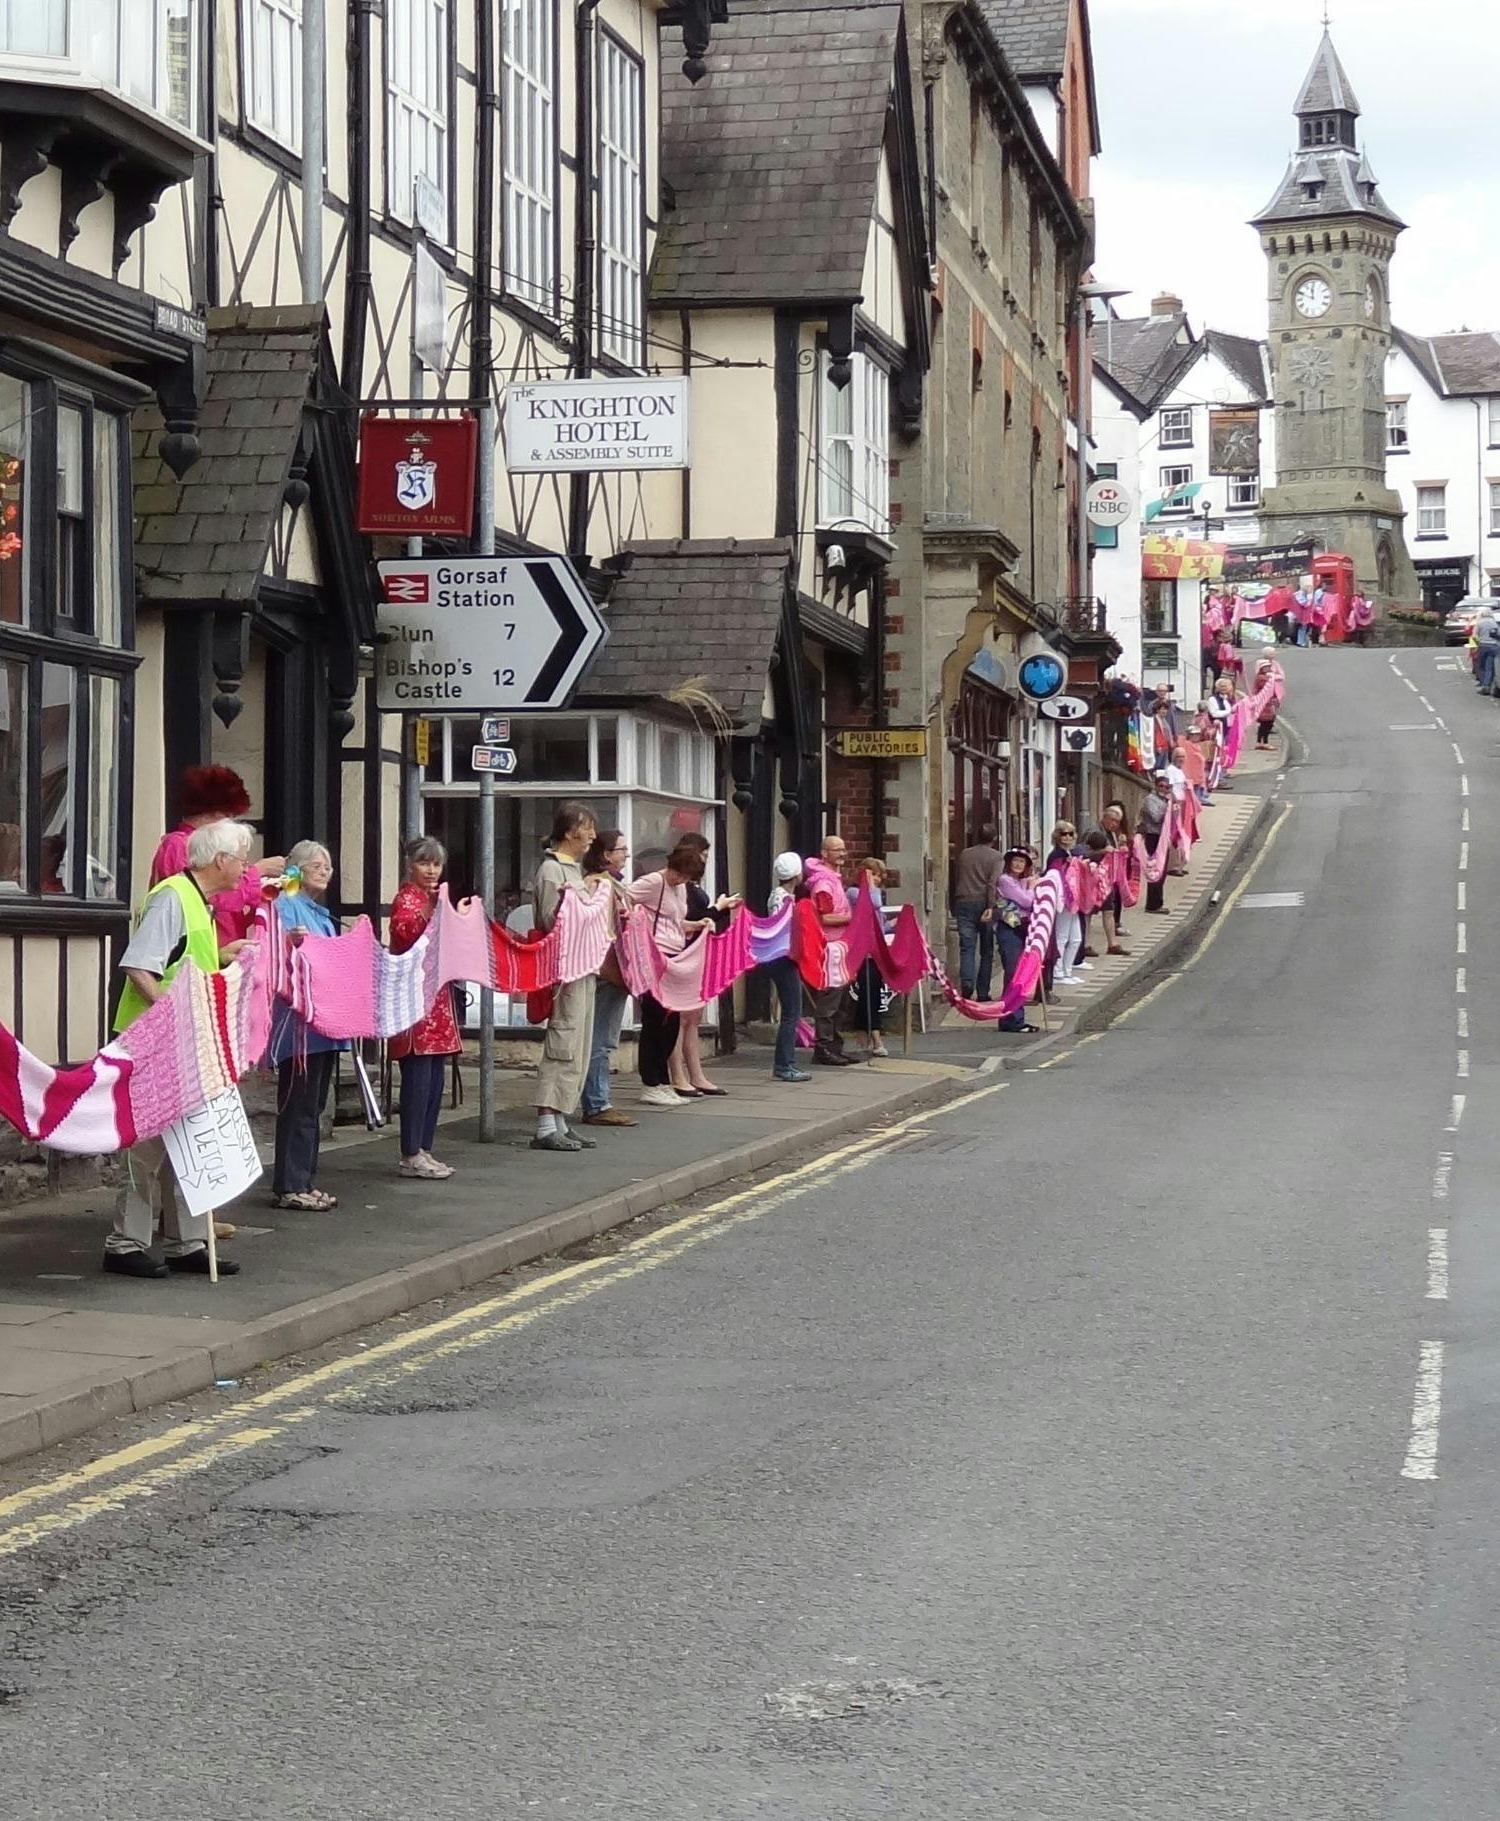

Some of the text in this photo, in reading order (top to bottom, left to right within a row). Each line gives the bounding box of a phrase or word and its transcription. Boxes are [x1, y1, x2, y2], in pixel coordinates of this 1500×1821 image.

[512, 387, 535, 402] The
[527, 395, 677, 420] KNIGHTON
[554, 421, 649, 443] HOTEL
[530, 445, 673, 461] & ASSEMBLY SUITE
[1088, 501, 1128, 514] HSBC
[372, 513, 456, 524] NORTON ARMS
[437, 566, 508, 585] Gorsaf
[437, 590, 515, 608] Station
[504, 623, 516, 641] 7
[386, 658, 515, 686] Bishop's 12
[395, 682, 463, 699] Castle
[850, 732, 890, 743] PUBLIC
[850, 743, 919, 754] LAVATORIES
[193, 1128, 228, 1190] DETOUR
